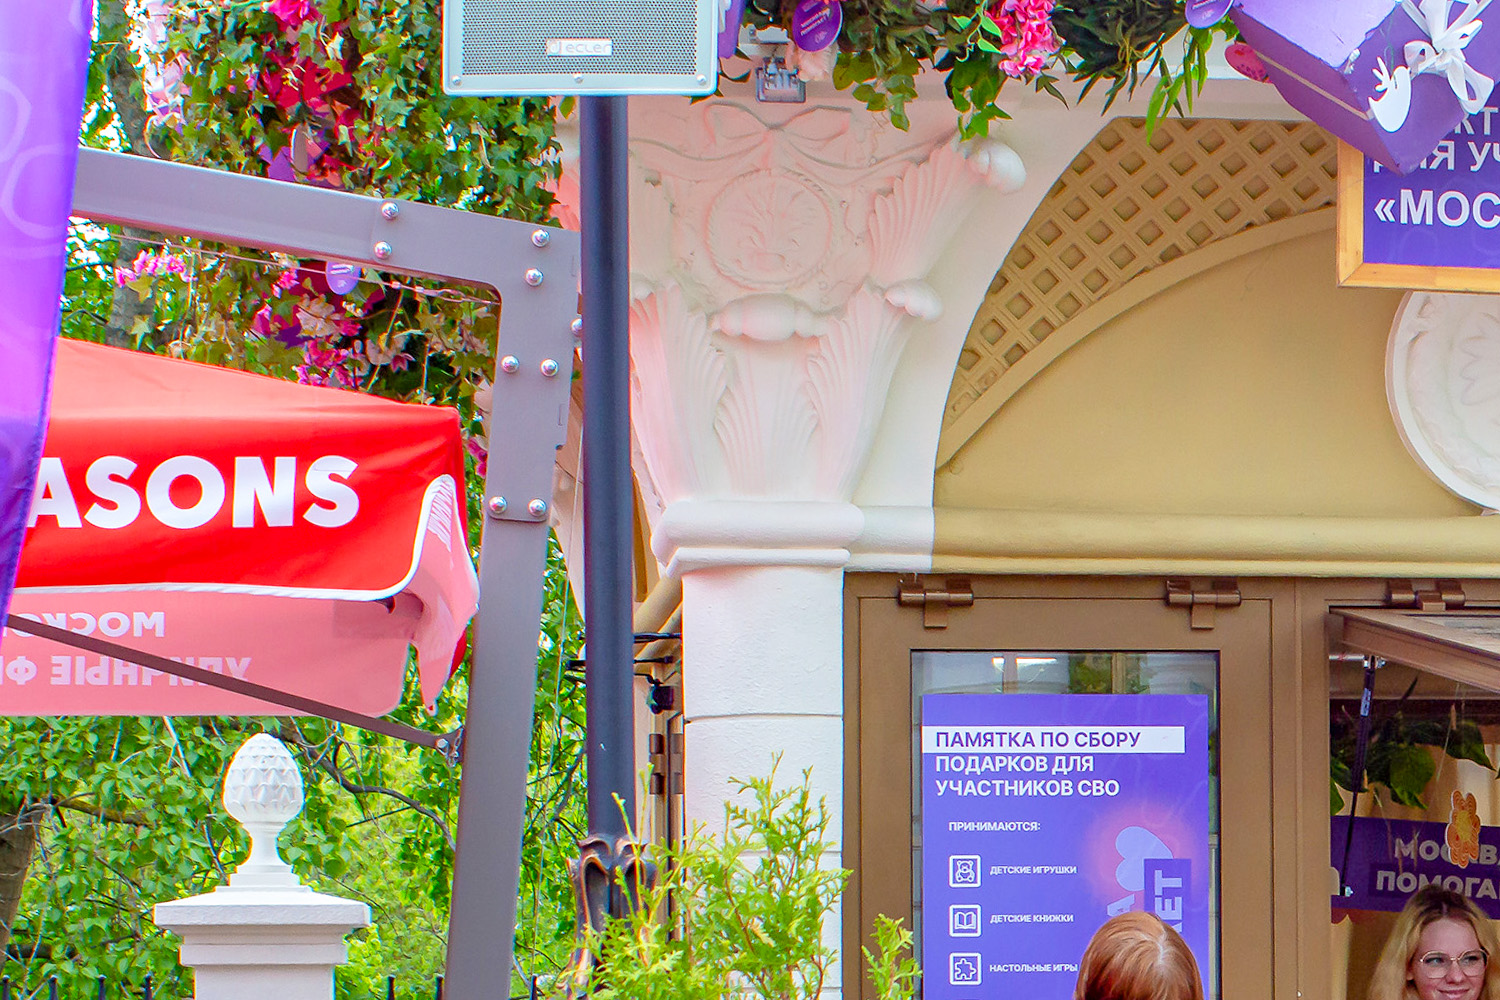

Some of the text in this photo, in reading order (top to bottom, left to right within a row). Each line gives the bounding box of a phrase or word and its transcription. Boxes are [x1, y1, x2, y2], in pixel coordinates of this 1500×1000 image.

[935, 731, 1142, 748] ПАМЯТКА ПО СБОРУ
[935, 756, 1094, 775] ПОДАРКОВ ДЛЯ
[935, 780, 1120, 797] УЧАСТНИКОВ СВО
[949, 821, 1041, 832] ПРИНИМАЮТСЯ:
[990, 865, 1077, 875] ДЕТСКИЕ ИГРУШКИ
[990, 914, 1074, 924] ДЕТСКИЕ КНИЖКИ
[989, 963, 1078, 973] НАСТОЛЬНЫЕ ИГРЫ
